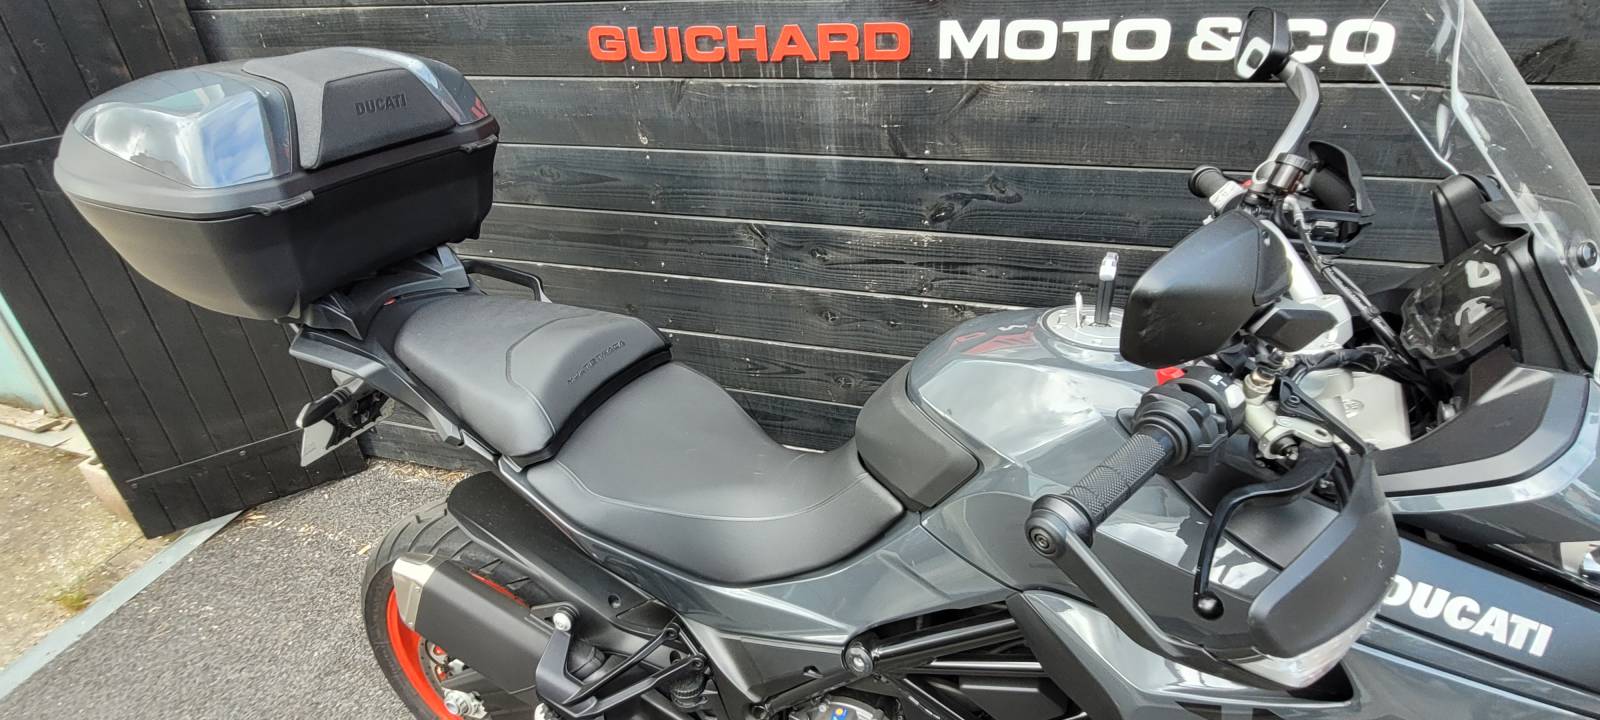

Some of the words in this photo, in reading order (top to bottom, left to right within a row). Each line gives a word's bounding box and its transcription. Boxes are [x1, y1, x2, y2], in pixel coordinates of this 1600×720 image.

[587, 22, 912, 63] GUICHARD
[938, 18, 1171, 62] MOTO
[354, 93, 407, 116] DUCATI
[1382, 574, 1553, 658] DUCATI
